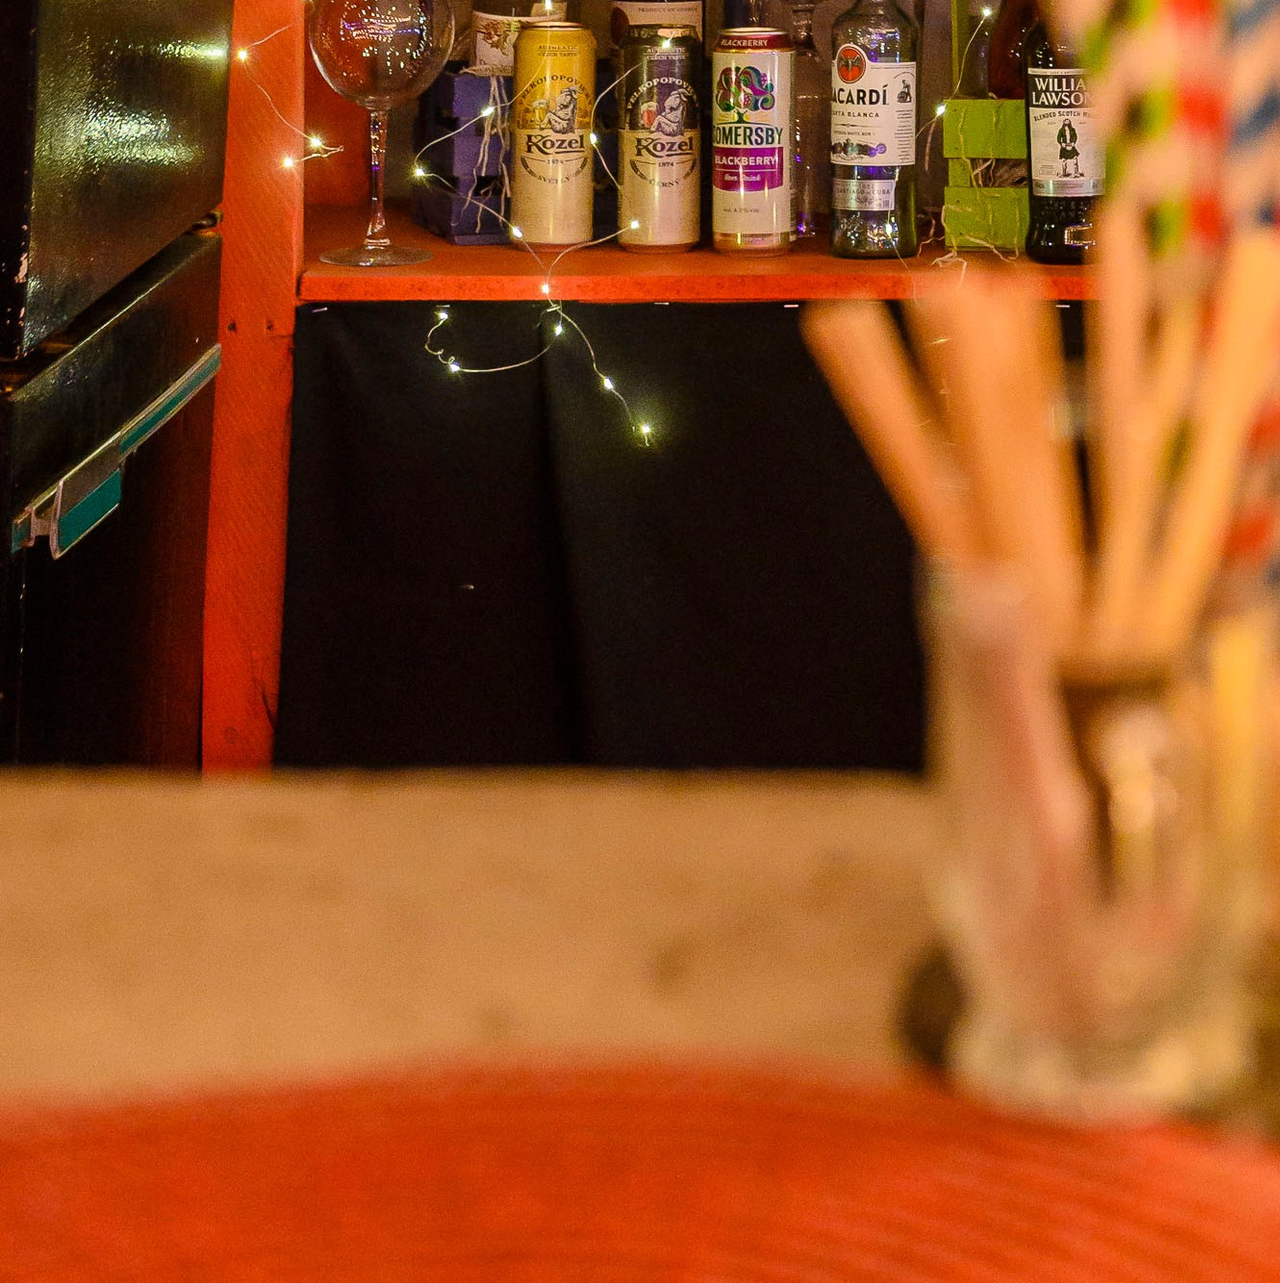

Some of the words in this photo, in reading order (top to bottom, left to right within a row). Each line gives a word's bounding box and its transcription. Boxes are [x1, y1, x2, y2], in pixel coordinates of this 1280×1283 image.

[720, 39, 769, 47] BLACKBERRY
[1034, 77, 1087, 91] WILLIA
[831, 83, 888, 106] ACARDÍ
[1034, 111, 1056, 122] BLENDED
[1058, 110, 1080, 118] SCOTCH
[526, 135, 585, 154] Kozel
[635, 136, 694, 159] Kozel
[714, 155, 776, 166] BLACKBERRY
